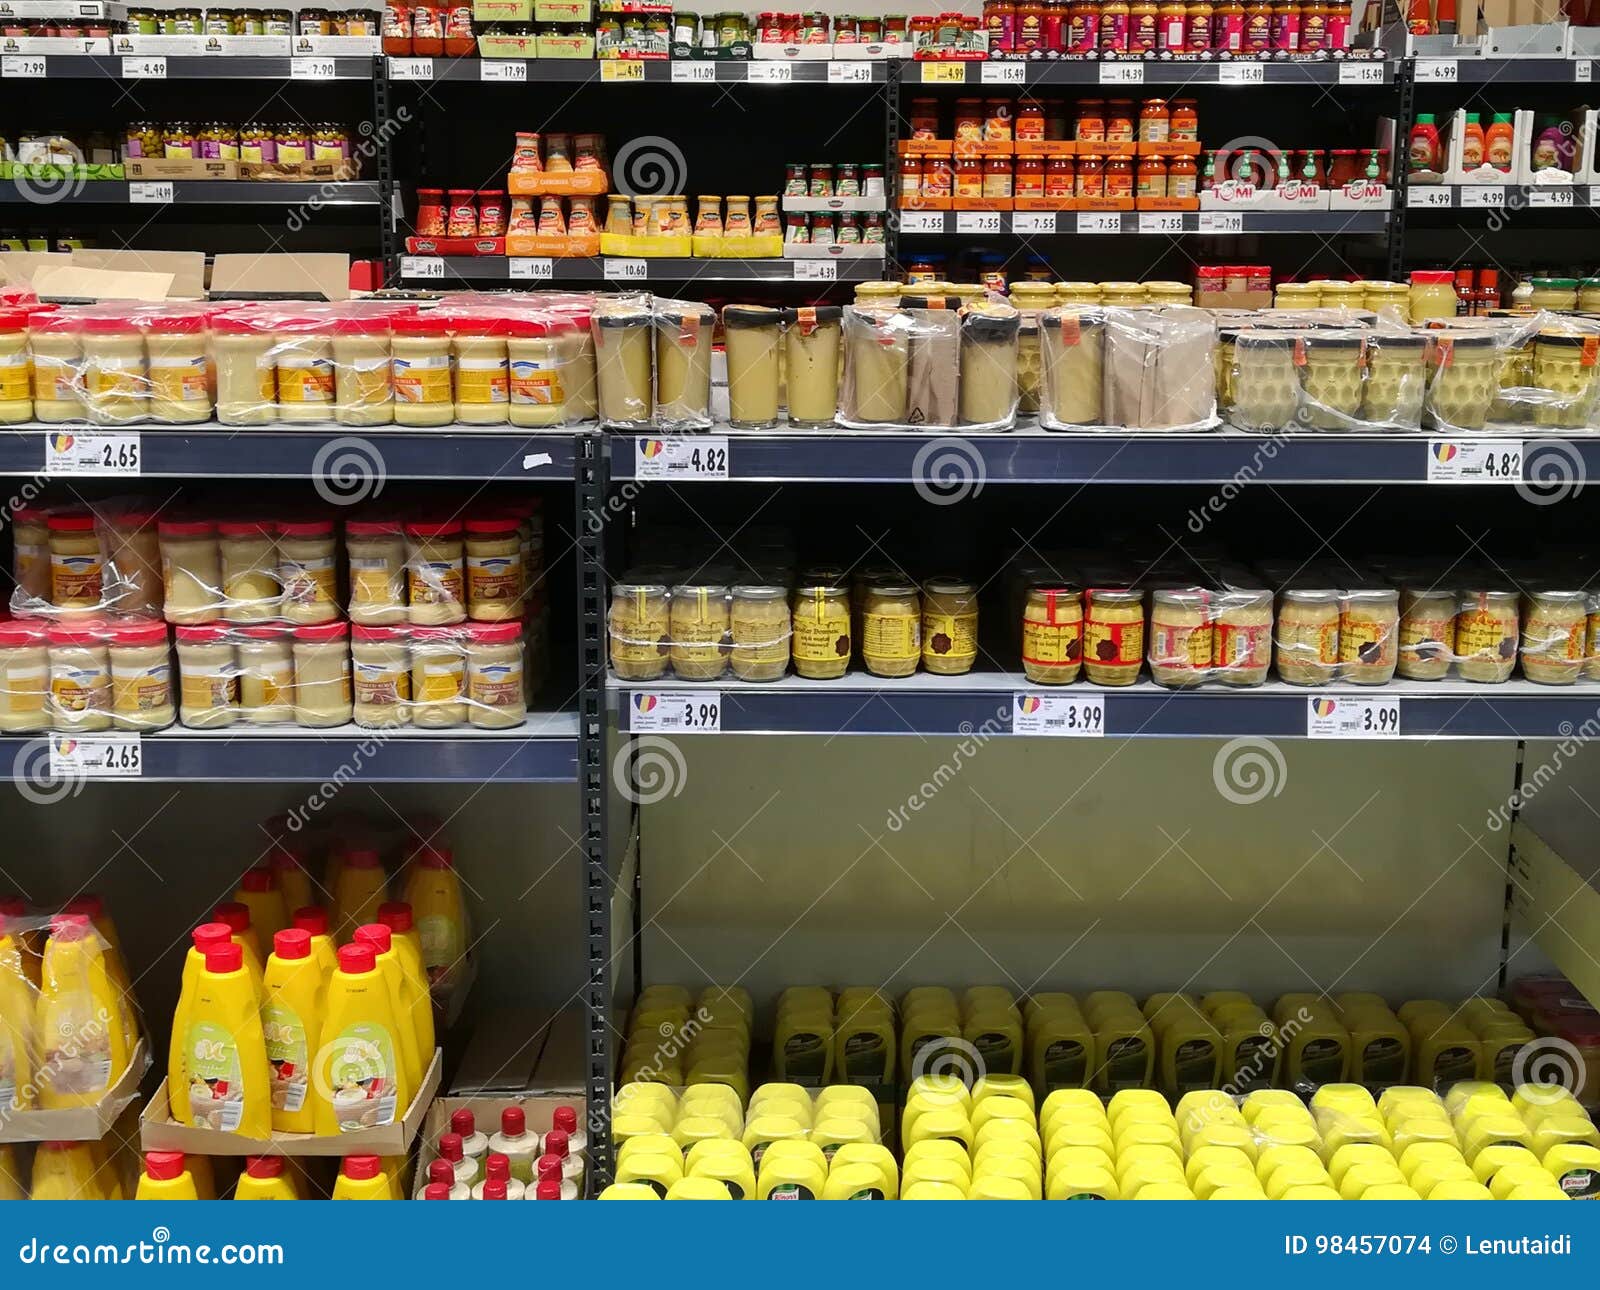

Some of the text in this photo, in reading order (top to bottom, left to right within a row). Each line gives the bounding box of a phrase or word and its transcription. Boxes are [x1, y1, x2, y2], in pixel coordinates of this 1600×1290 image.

[23, 62, 45, 75] 7.99
[143, 63, 165, 75] 4.49
[312, 64, 334, 75] 7.90
[410, 64, 432, 76] 10.10
[504, 66, 526, 77] 17.99
[627, 65, 643, 77] 4.99
[693, 67, 714, 78] 11.09
[769, 67, 790, 79] 5.99
[854, 68, 870, 80] 4.39
[948, 67, 964, 79] 4.99
[1003, 68, 1024, 79] 15.49
[1121, 68, 1143, 80] 14.39
[1241, 68, 1263, 80] 15.49
[1361, 68, 1383, 80] 15.49
[1434, 66, 1456, 77] 6.99
[1213, 187, 1252, 201] TOMI
[1277, 185, 1316, 199] TOMI
[1342, 185, 1381, 199] TOMI
[1482, 192, 1503, 203] 4.99
[1550, 192, 1572, 202] 4.99
[1429, 194, 1450, 204] 4.99
[922, 217, 942, 228] 7.55
[978, 217, 999, 228] 7.55
[1034, 217, 1054, 229] 7.55
[1099, 217, 1119, 229] 7.55
[1161, 218, 1181, 229] 7.55
[1225, 218, 1240, 229] 7.99
[427, 265, 443, 276] 8.49
[530, 264, 551, 275] 10.60
[625, 264, 646, 276] 10.60
[819, 267, 835, 278] 4.39
[103, 444, 137, 467] 2.65
[691, 448, 726, 472] 4.82
[1485, 453, 1520, 477] 4.82
[685, 703, 718, 726] 3.99
[1068, 705, 1101, 728] 3.99
[1364, 707, 1397, 731] 3.99
[106, 745, 139, 768] 2.65
